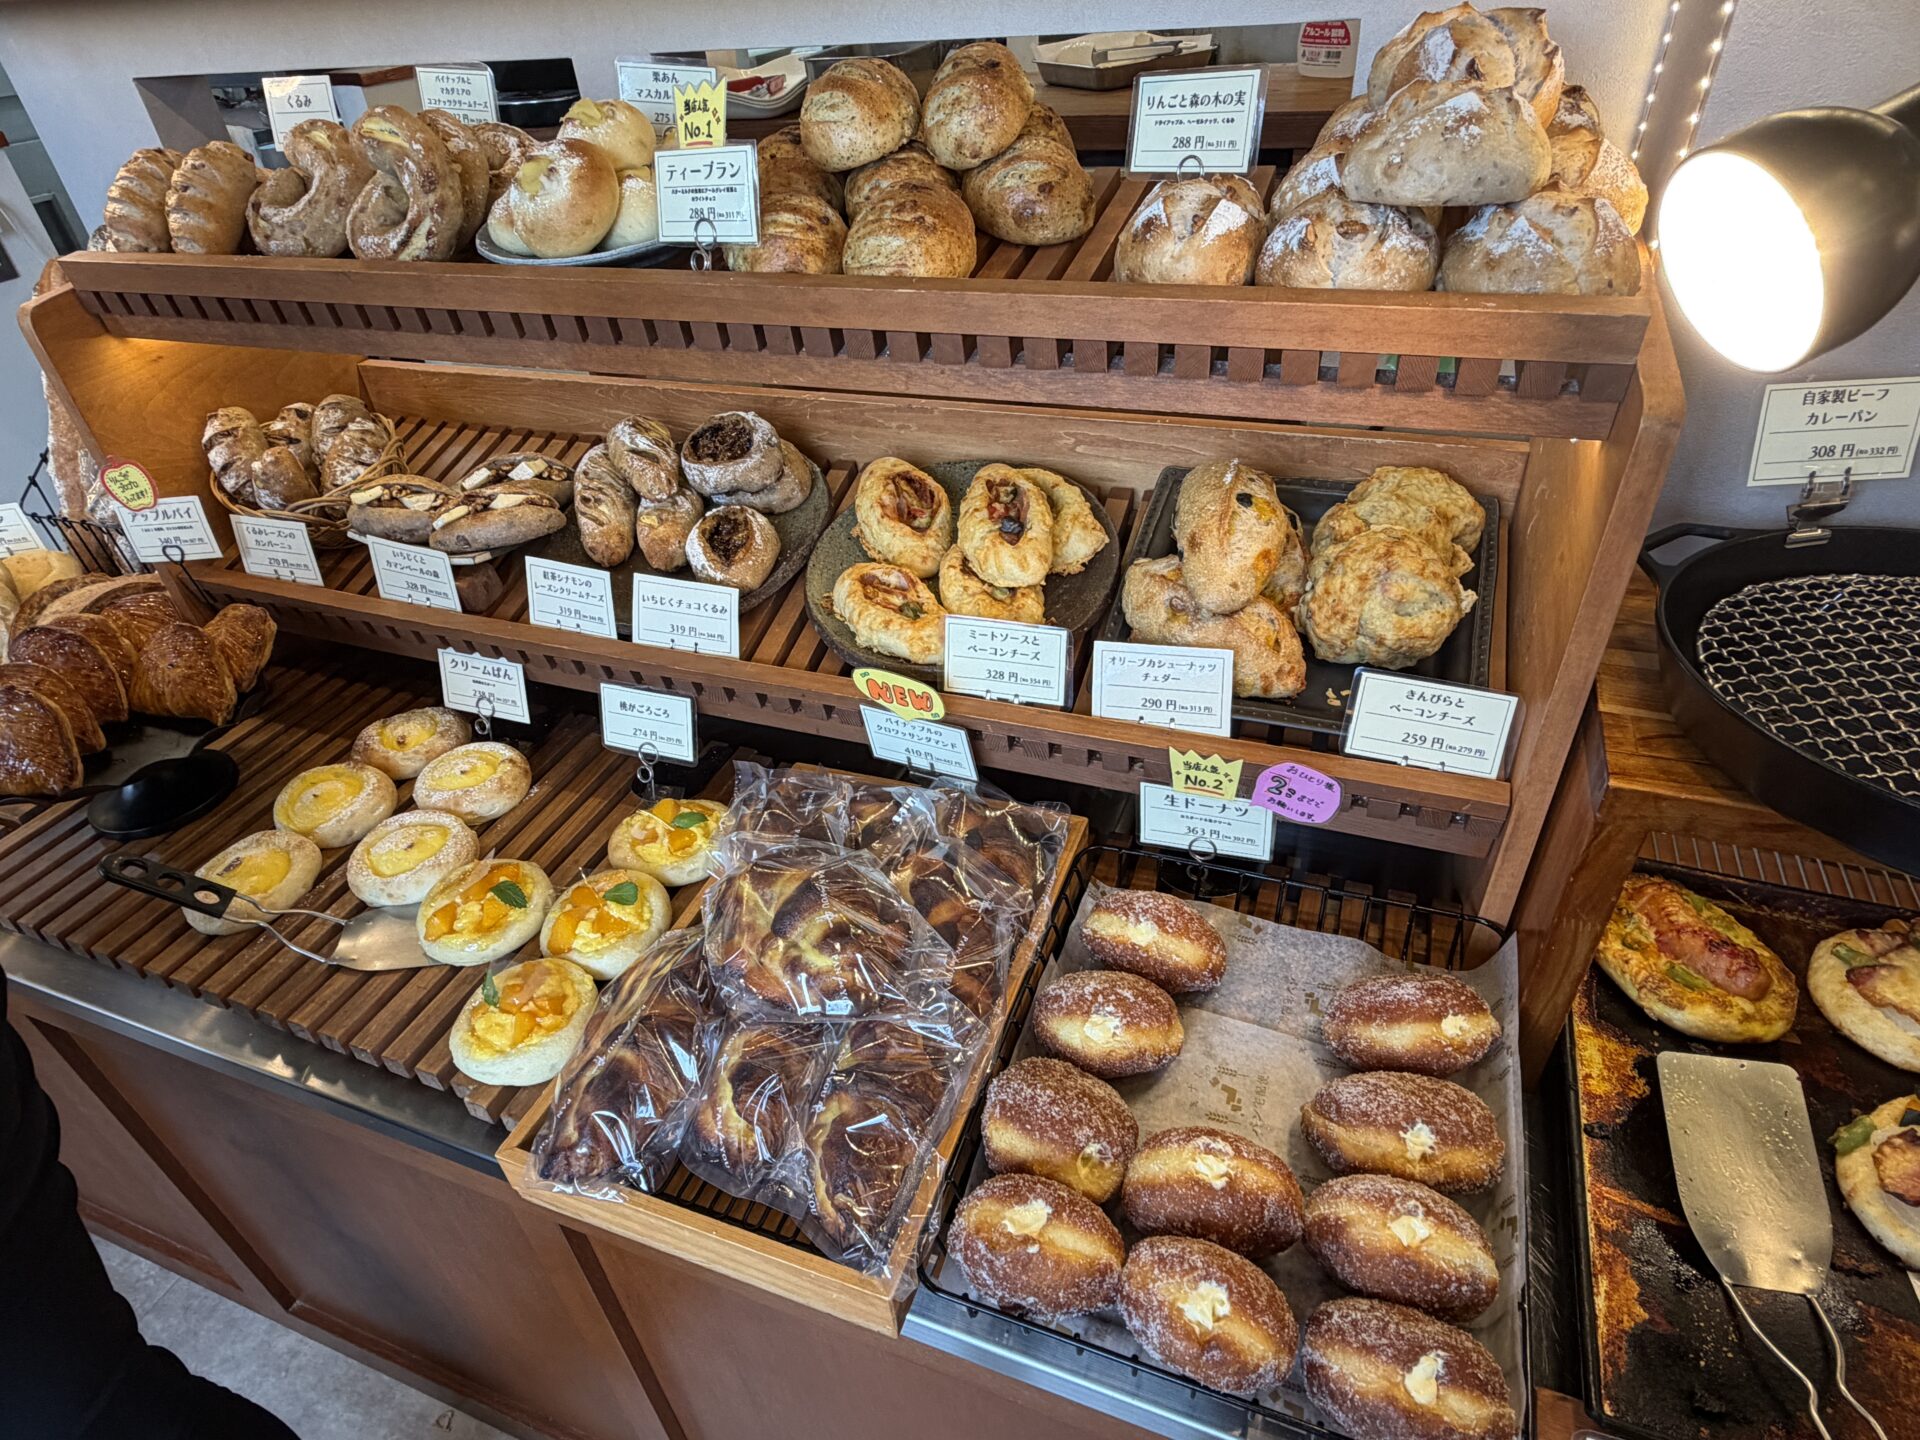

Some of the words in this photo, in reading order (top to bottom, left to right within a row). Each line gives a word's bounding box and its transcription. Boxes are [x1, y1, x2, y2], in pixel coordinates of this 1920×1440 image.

[1304, 27, 1346, 38] アルコール
[435, 75, 472, 85] パイナップルと
[651, 71, 680, 84] 栗あん
[440, 87, 471, 96] マカダミアの
[1147, 89, 1247, 110] りんごと森の木の実
[287, 94, 312, 108] くるみ
[683, 97, 710, 115] 当店人気
[684, 120, 713, 141] No.1
[1802, 388, 1890, 406] 自家製ビーフ
[1805, 410, 1878, 426] カレーパン
[128, 507, 192, 522] アップルパイ
[246, 526, 296, 539] くるみレーズンの
[255, 539, 292, 550] カンパーニュ
[391, 550, 427, 565] いちじくと
[386, 560, 440, 579] カマンベールの
[543, 570, 592, 588] 紅茶シナモンの
[534, 581, 605, 603] レーズンクリームチーズ
[642, 594, 728, 615] いちじくチョコくるみ
[969, 629, 1040, 647] ミートソースと
[967, 645, 1041, 661] ベーコンチーズ
[450, 658, 514, 681] クリームぱん
[1108, 656, 1217, 673] オリーブカシューナッツ
[1142, 672, 1181, 683] チェダー
[866, 678, 934, 712] NEW
[1405, 689, 1465, 709] きんぴらと
[1389, 704, 1476, 727] ベーコンチーズ
[885, 717, 943, 737] パイナップルの
[876, 724, 958, 749] クロワッサンダマンド
[1183, 761, 1221, 775] 当店人気
[1184, 774, 1224, 790] No.2
[1286, 765, 1336, 793] おひとり様
[1163, 794, 1248, 817] 生ドーナツ
[720, 1146, 730, 1169] YOU
